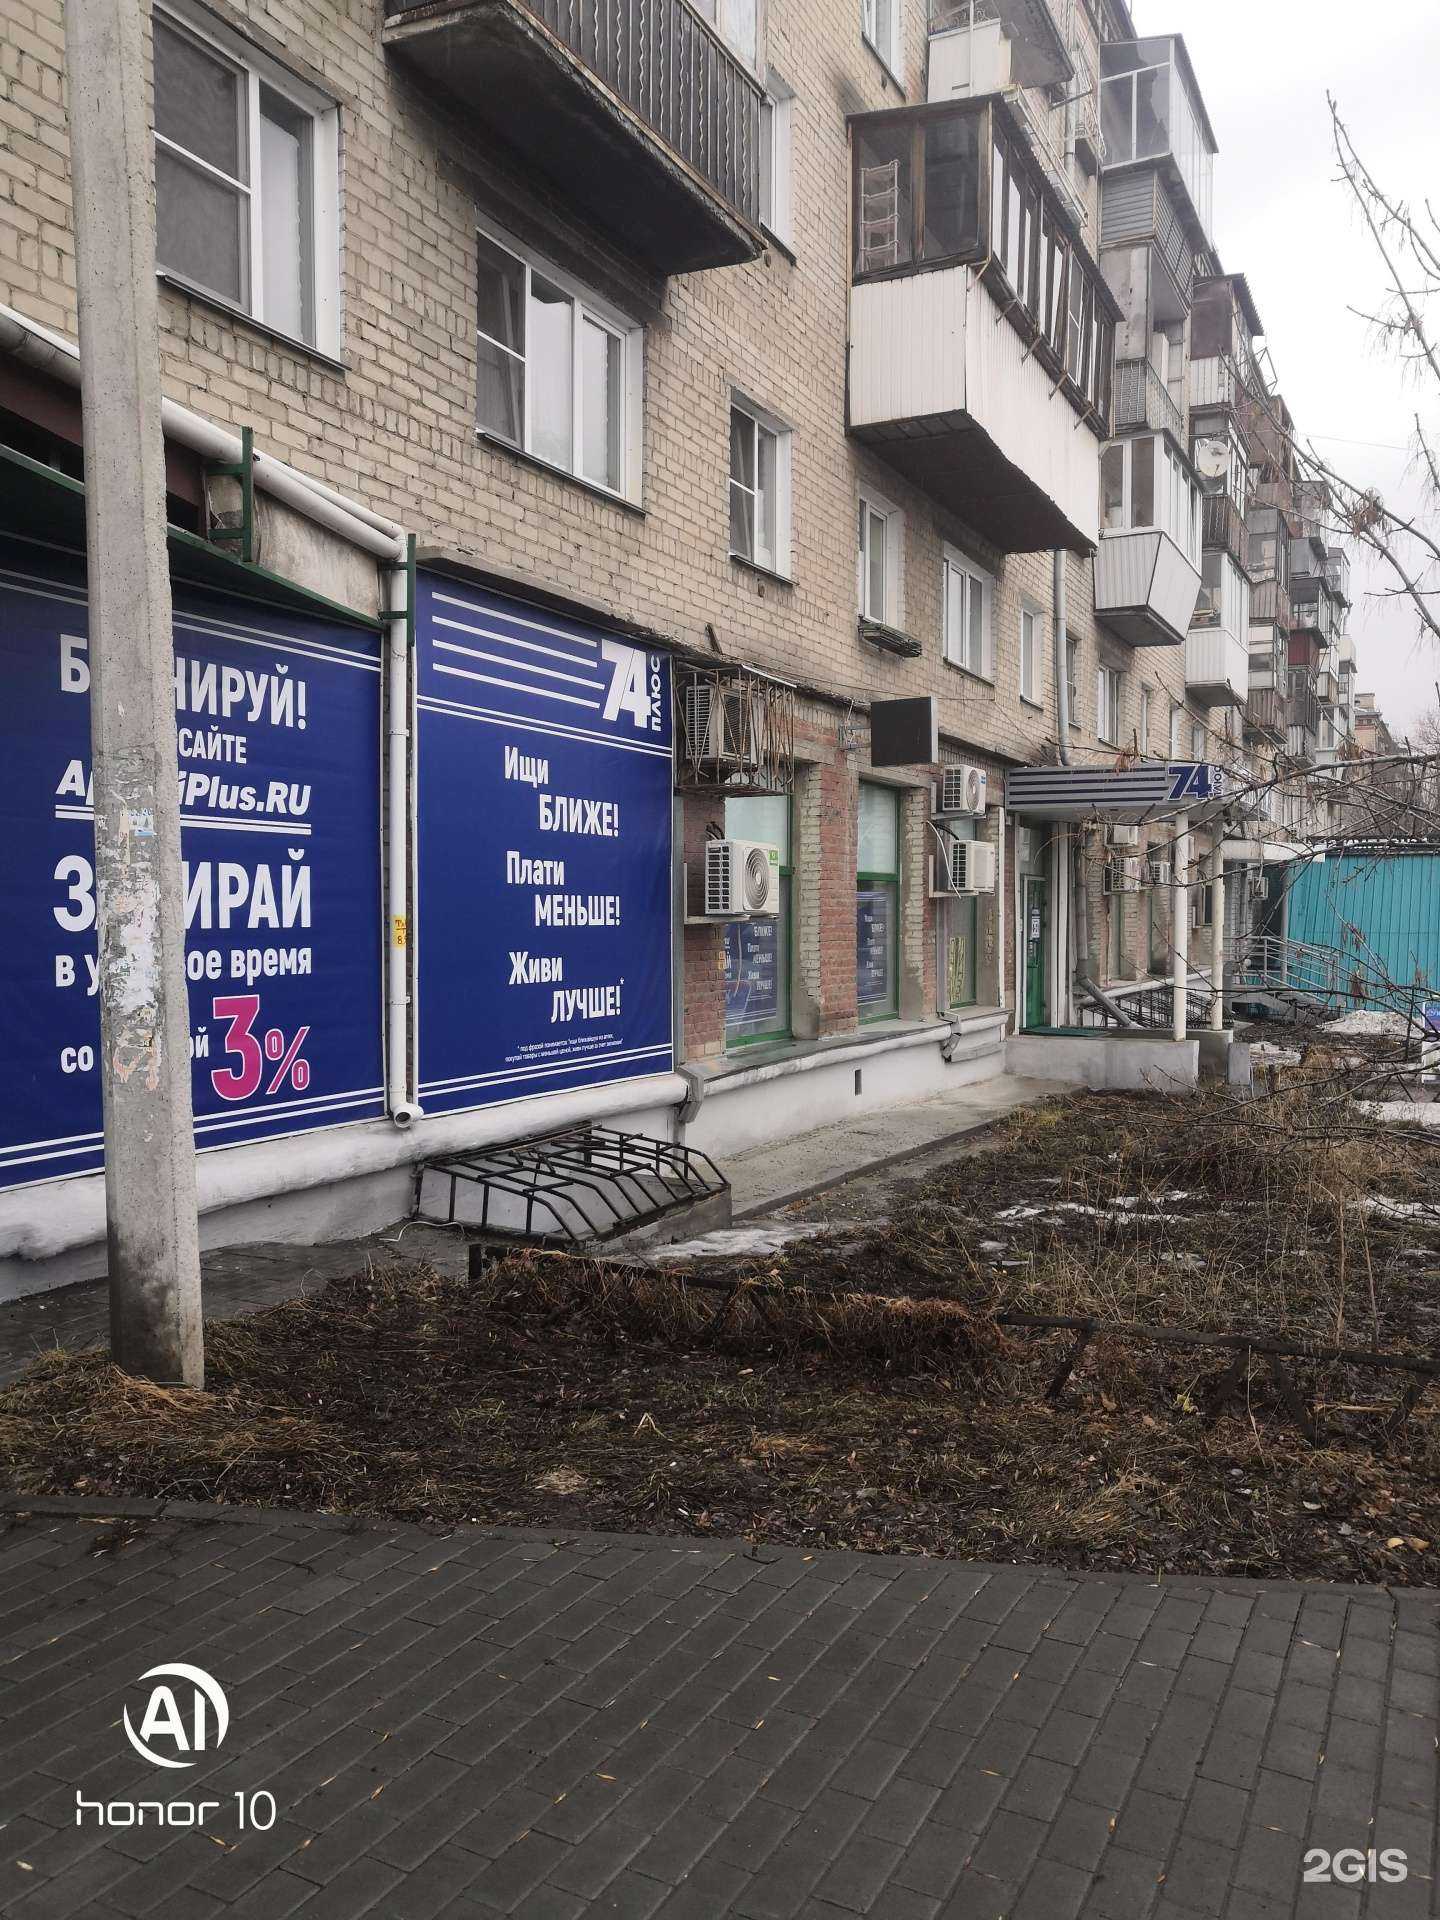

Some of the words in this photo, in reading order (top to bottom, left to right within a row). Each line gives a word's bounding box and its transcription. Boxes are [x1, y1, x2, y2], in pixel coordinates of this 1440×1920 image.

[60, 633, 306, 730] БИРУЙ!
[601, 638, 651, 728] 74
[650, 655, 661, 732] ПЛЮС
[178, 725, 247, 764] САЙТЕ
[55, 759, 312, 817] AiPlus.RU
[504, 745, 549, 788] Ищи
[1167, 764, 1213, 801] 74
[539, 793, 619, 837] БЛИЖЕ!
[506, 850, 565, 886] Плати
[53, 848, 311, 932] ЗИРАЙ
[534, 894, 621, 926] МЕНЬШЕ!
[55, 955, 75, 987] в
[230, 947, 312, 986] время
[508, 951, 563, 985] Живи
[60, 1046, 94, 1074] со
[211, 994, 311, 1101] 3%
